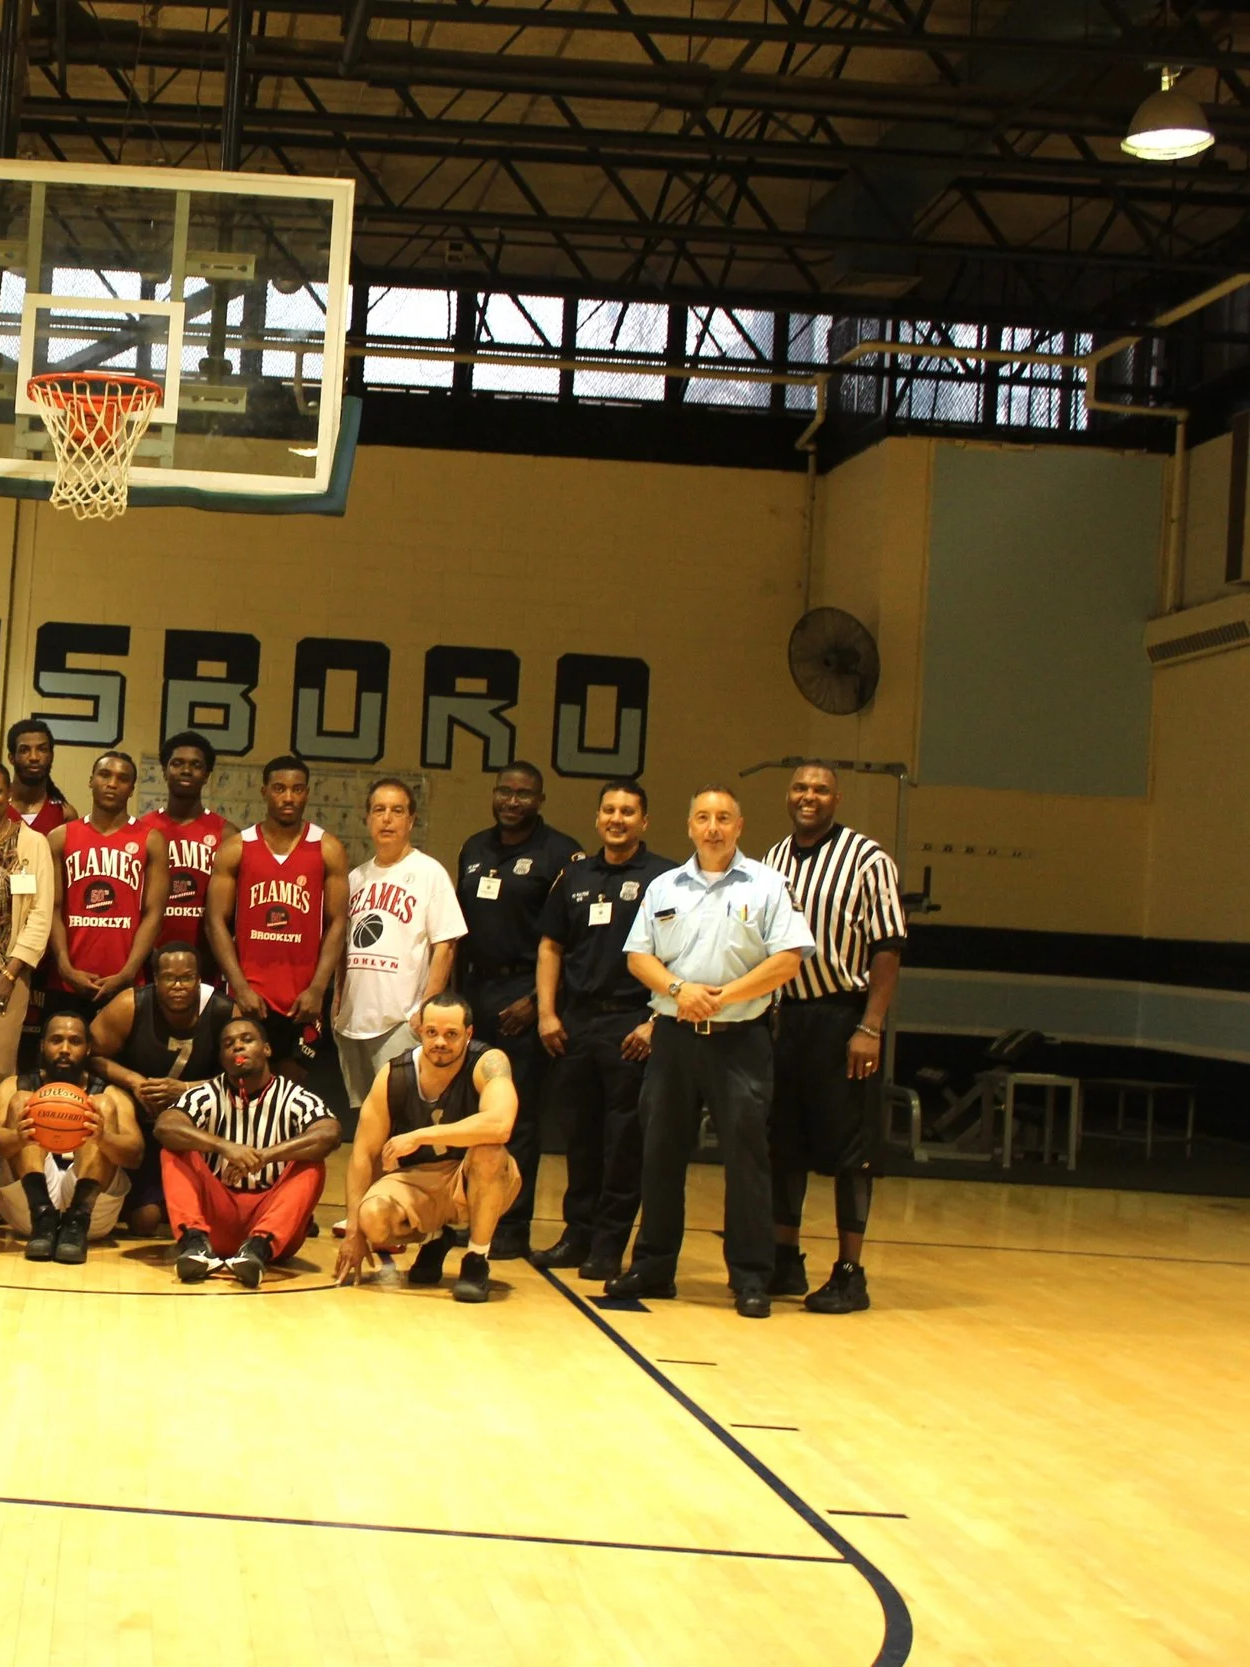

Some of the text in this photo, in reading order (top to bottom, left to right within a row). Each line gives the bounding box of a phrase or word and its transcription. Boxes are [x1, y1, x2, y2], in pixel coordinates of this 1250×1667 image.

[169, 839, 217, 876] AME
[65, 847, 142, 890] FLAMES
[250, 880, 310, 914] FLAMES
[164, 906, 206, 918] OOKLY
[68, 915, 131, 929] BROOKLYN
[250, 929, 302, 943] BROOKLYN
[348, 957, 399, 970] OKLYN
[38, 1087, 85, 1105] Wilson
